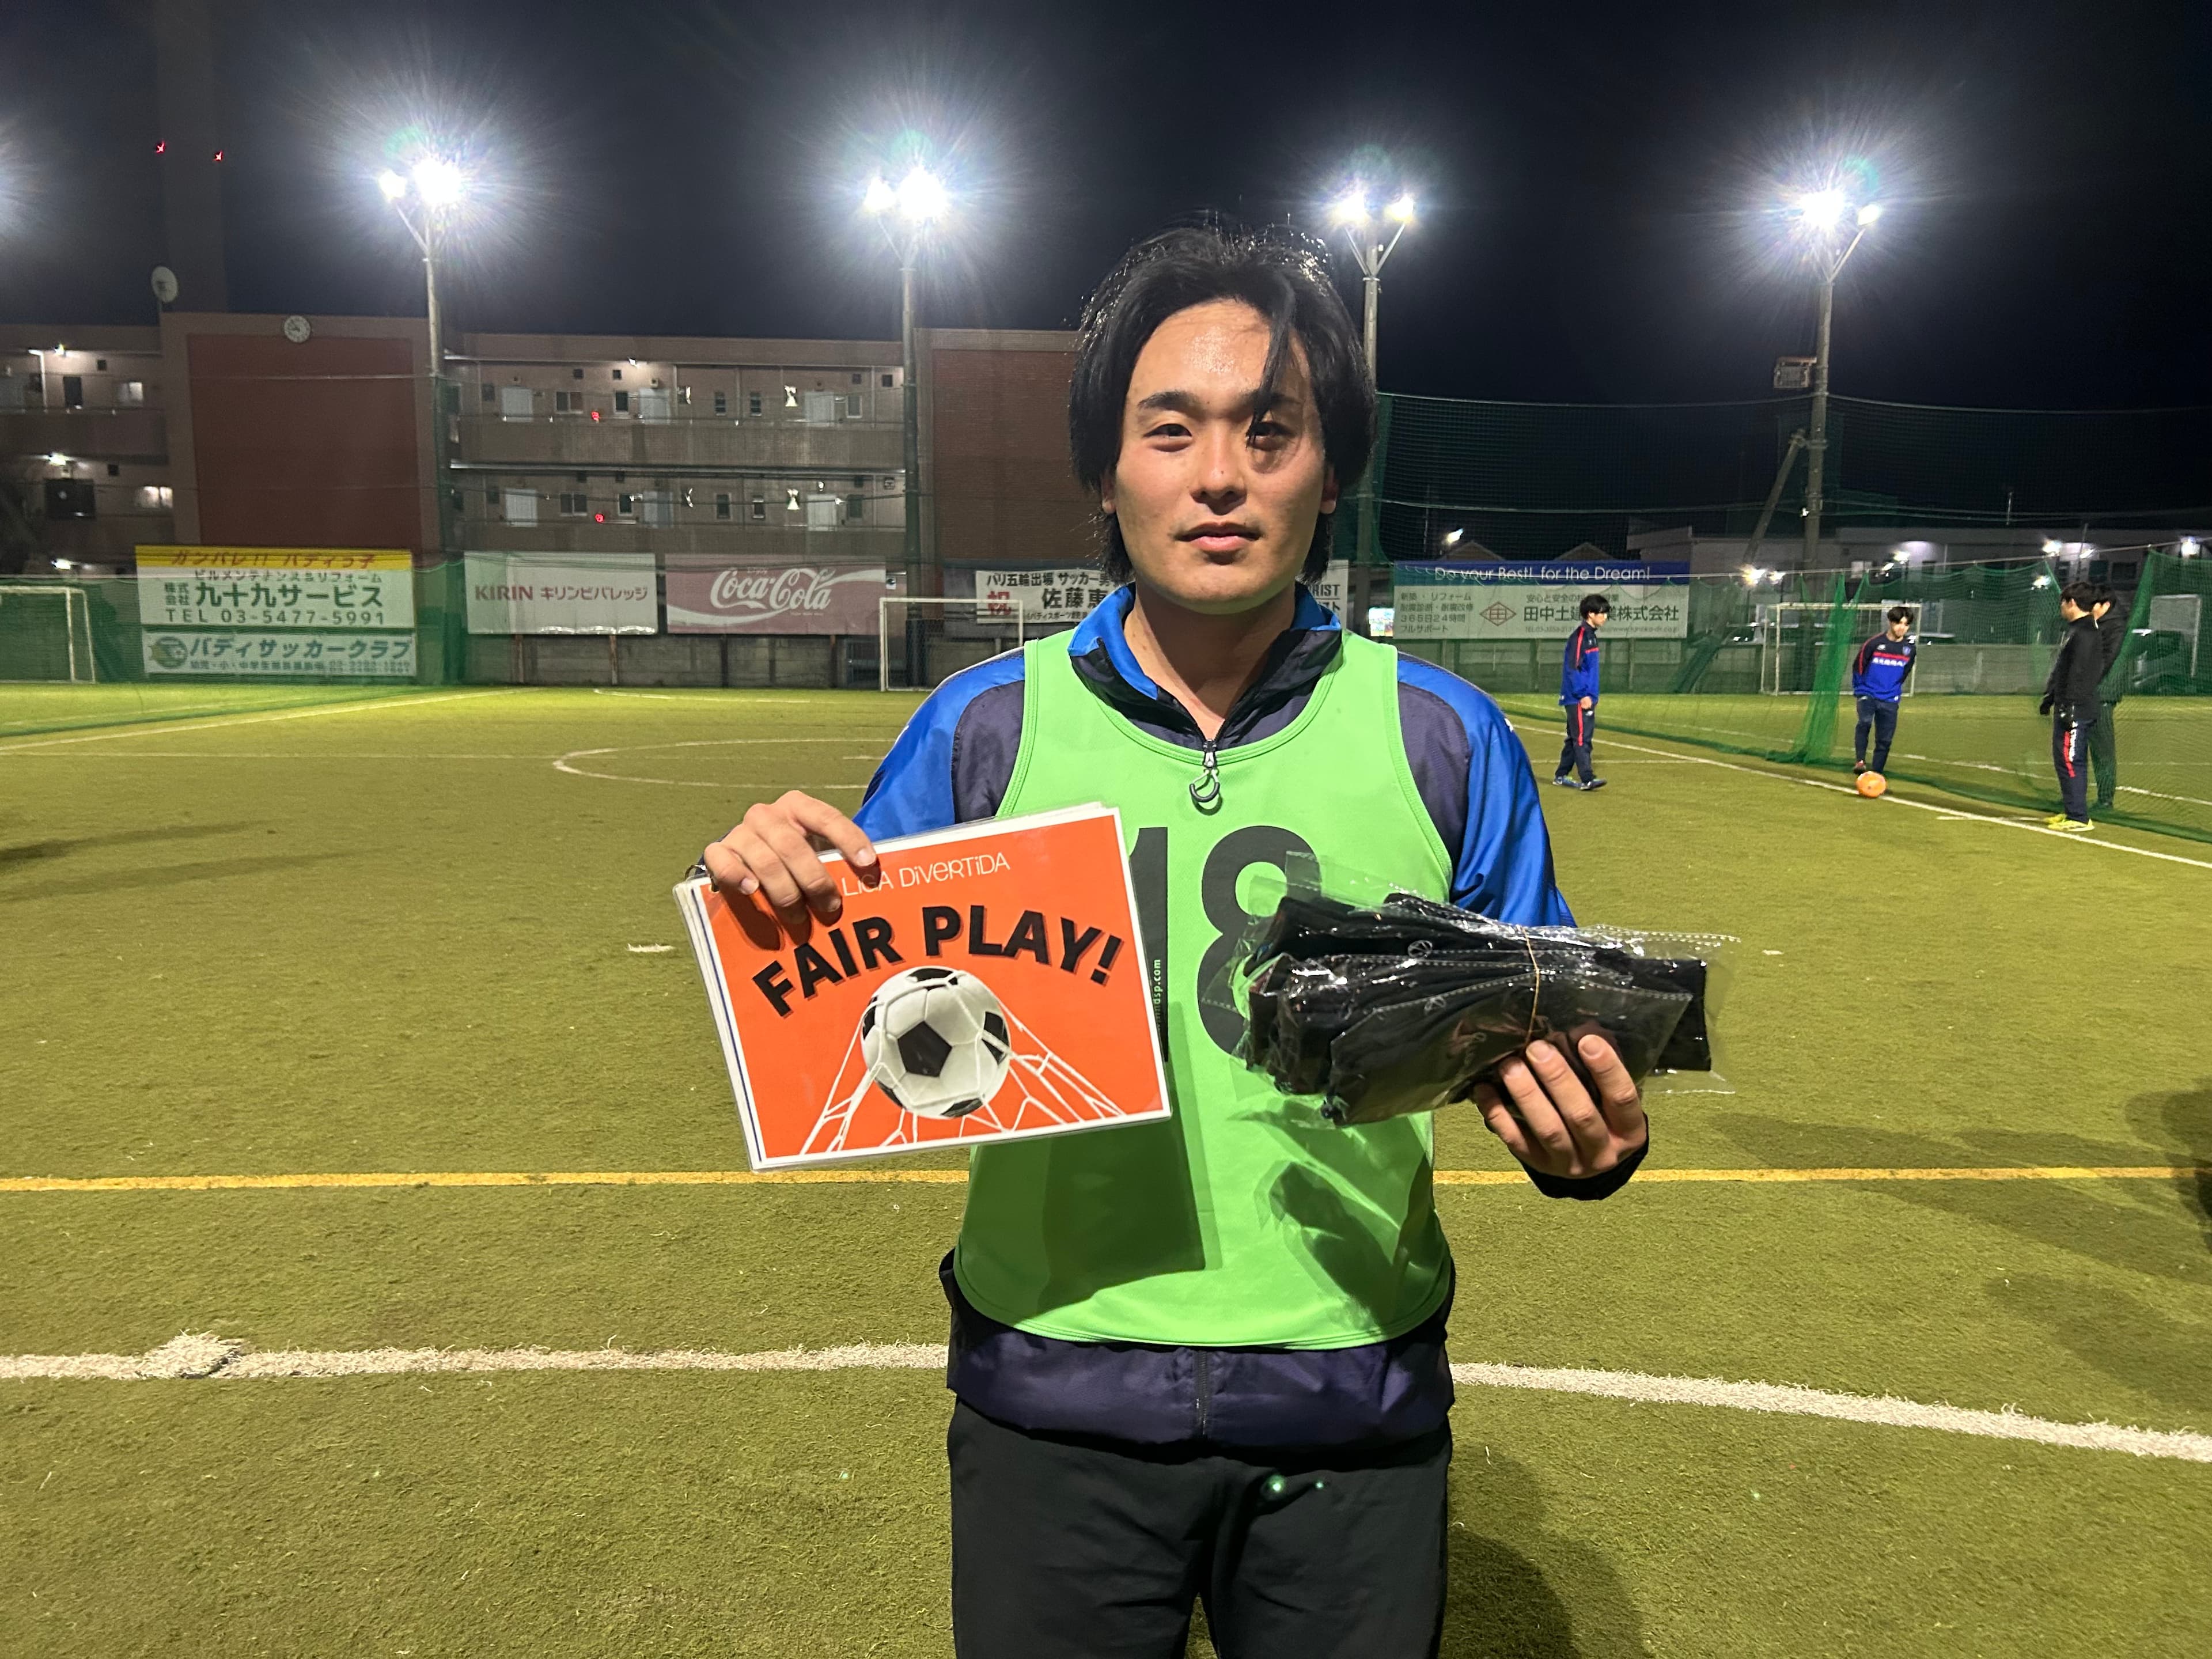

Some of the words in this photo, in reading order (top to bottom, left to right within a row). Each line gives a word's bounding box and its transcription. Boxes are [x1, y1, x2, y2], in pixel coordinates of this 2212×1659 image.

[1541, 566, 1561, 580] for
[1565, 567, 1589, 581] the
[1594, 567, 1650, 581] Dream!
[195, 581, 382, 608] 九十九サービス
[475, 585, 533, 601] KIRIN
[540, 586, 648, 601] キリンビバレッジ
[710, 568, 835, 610] Coca-Cola
[166, 609, 209, 623] TEL
[221, 608, 383, 625] 03-5477-5991
[190, 637, 412, 659] バディサッカークラブ
[752, 916, 903, 1018] FAIR
[922, 904, 1123, 986] PLAY!
